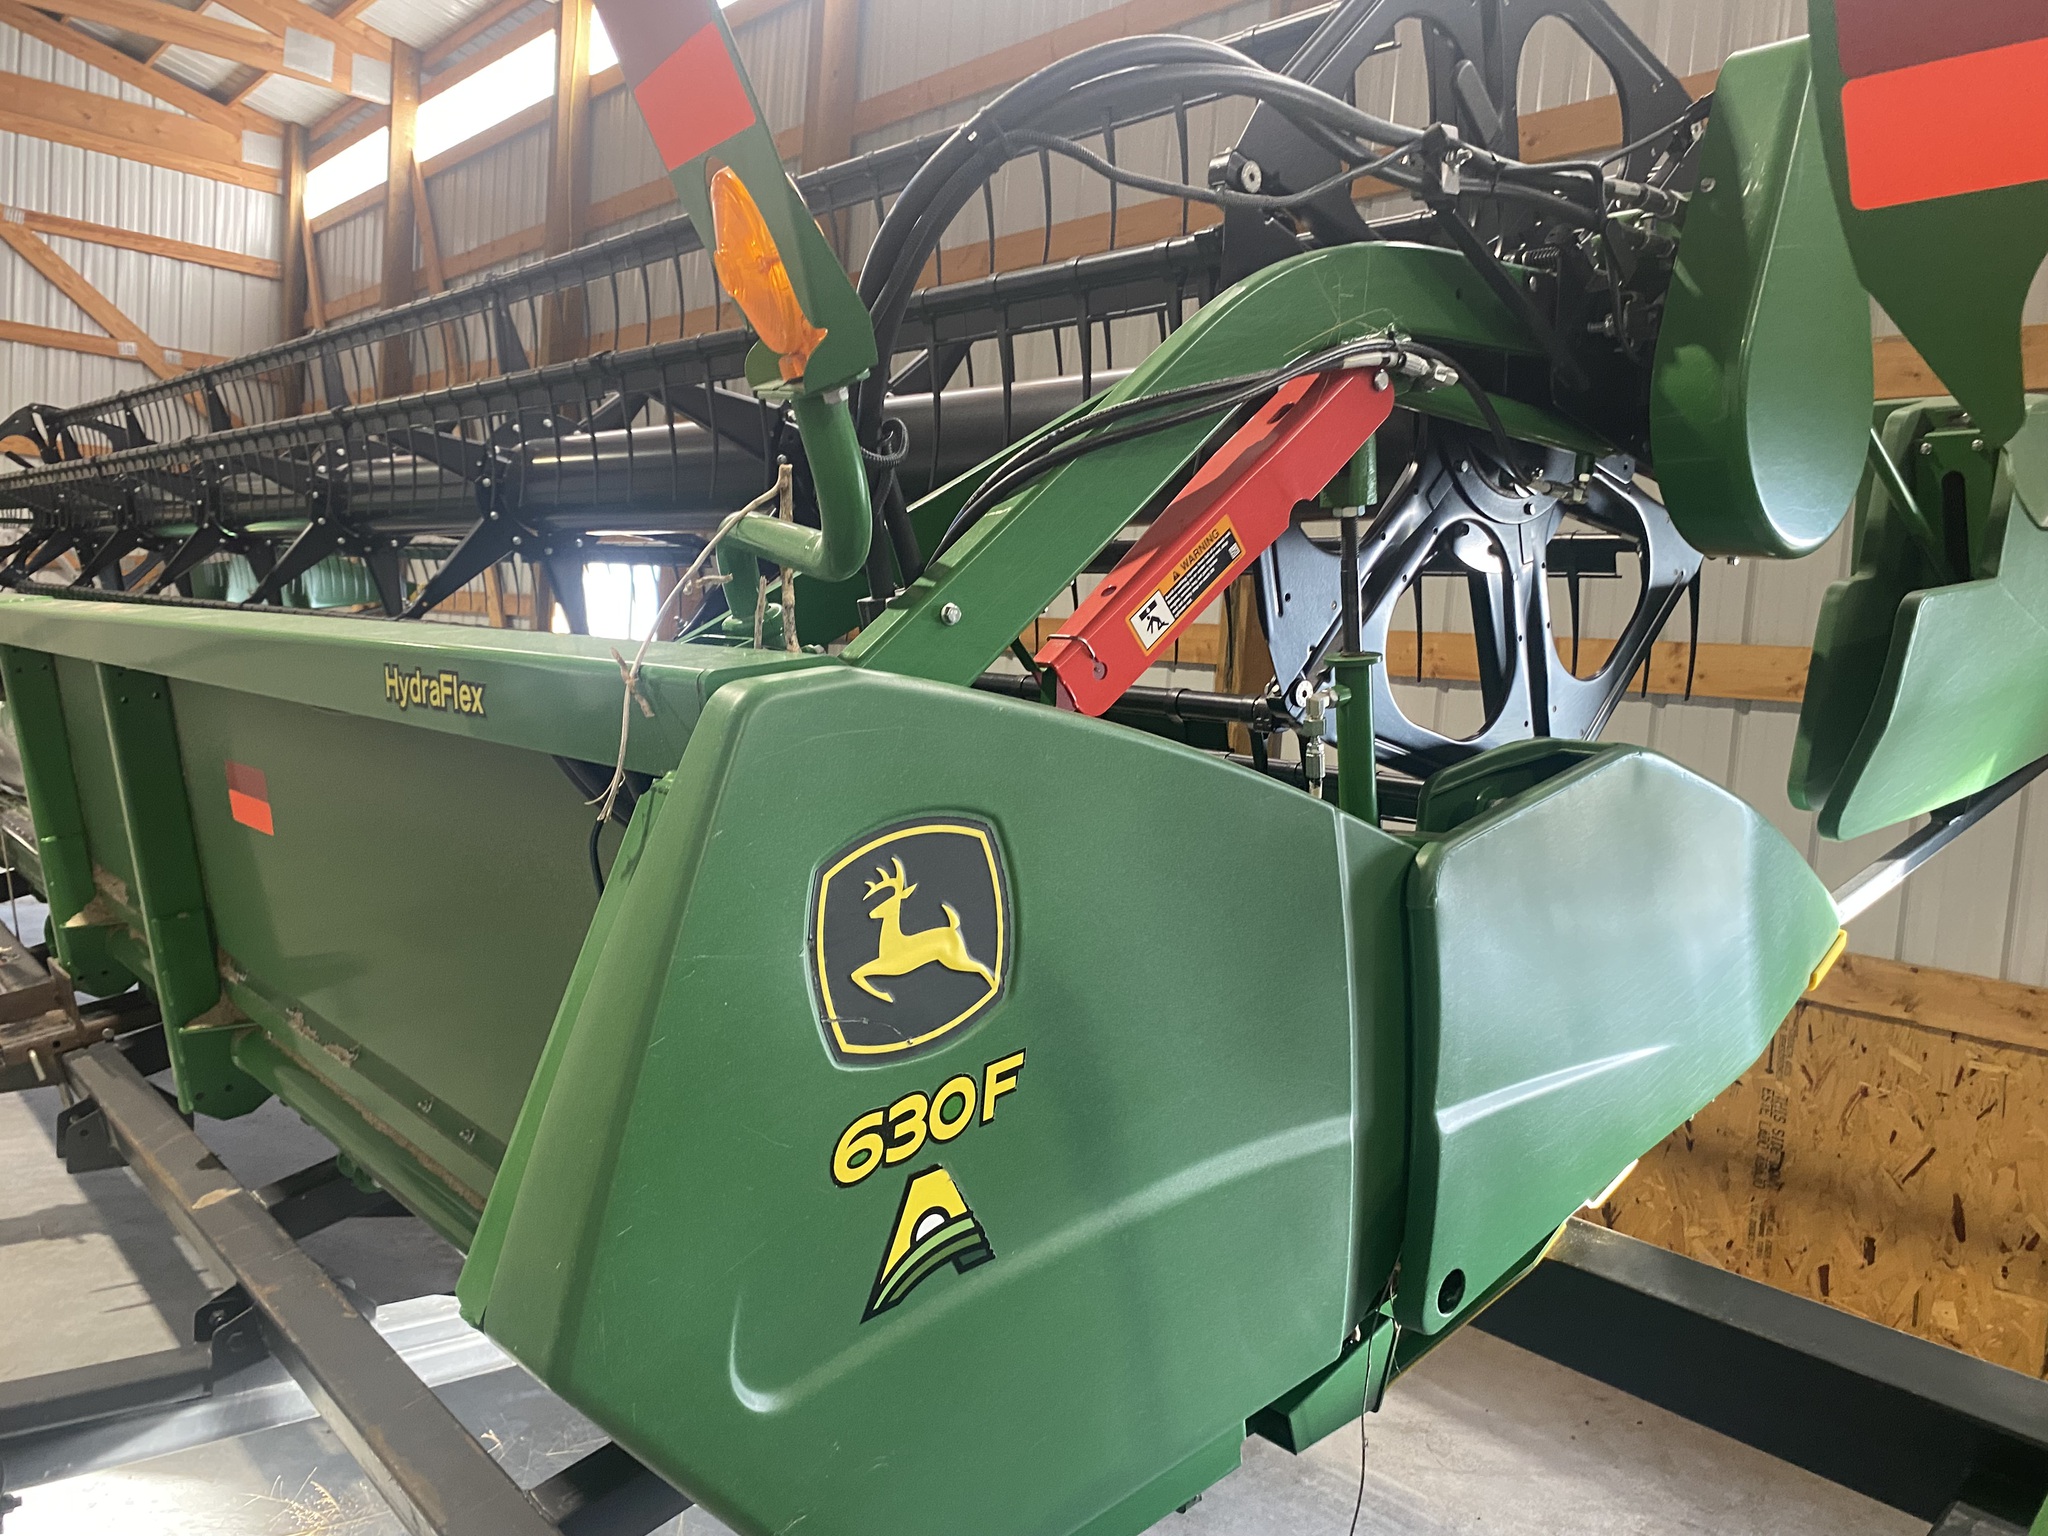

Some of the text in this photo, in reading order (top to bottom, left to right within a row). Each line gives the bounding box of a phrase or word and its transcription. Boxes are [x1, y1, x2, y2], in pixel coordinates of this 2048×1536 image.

[1180, 529, 1220, 571] WARNING
[384, 664, 485, 716] HydraFlex
[831, 1048, 1026, 1187] 630F
[1769, 1127, 1785, 1153] SIDE
